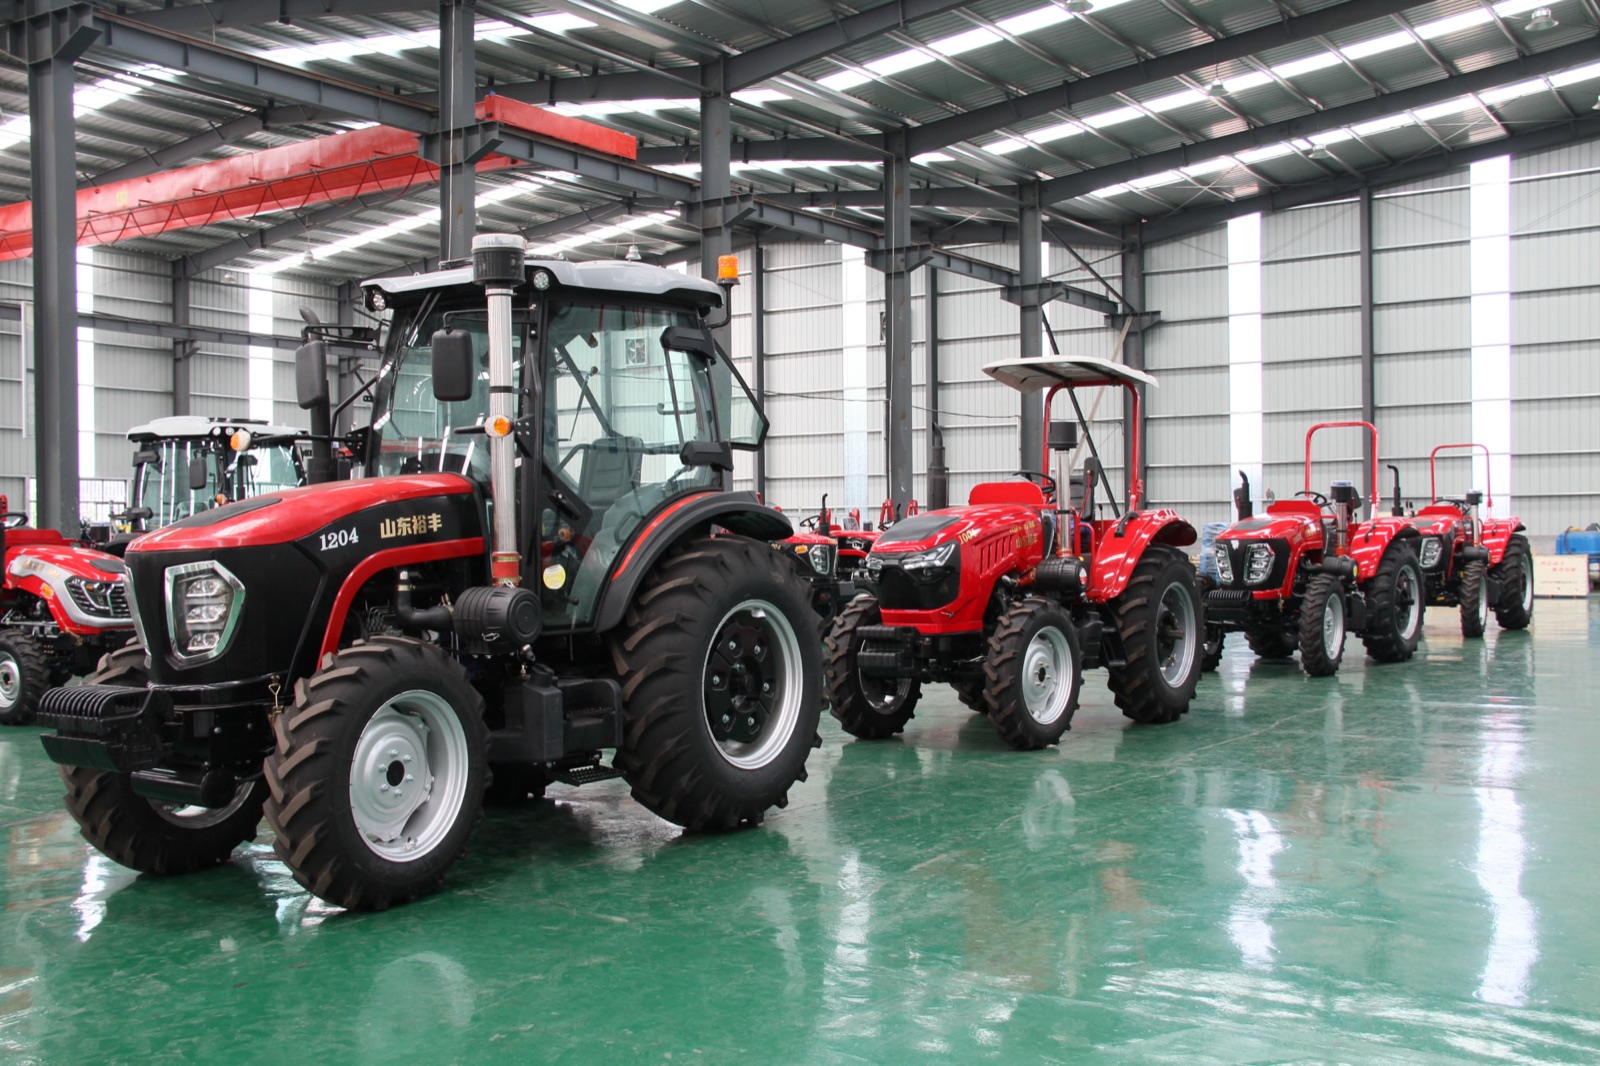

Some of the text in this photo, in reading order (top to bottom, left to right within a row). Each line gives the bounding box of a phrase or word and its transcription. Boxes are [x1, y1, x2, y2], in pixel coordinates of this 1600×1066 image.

[380, 513, 442, 538] 山东裕丰
[319, 526, 359, 551] 1204
